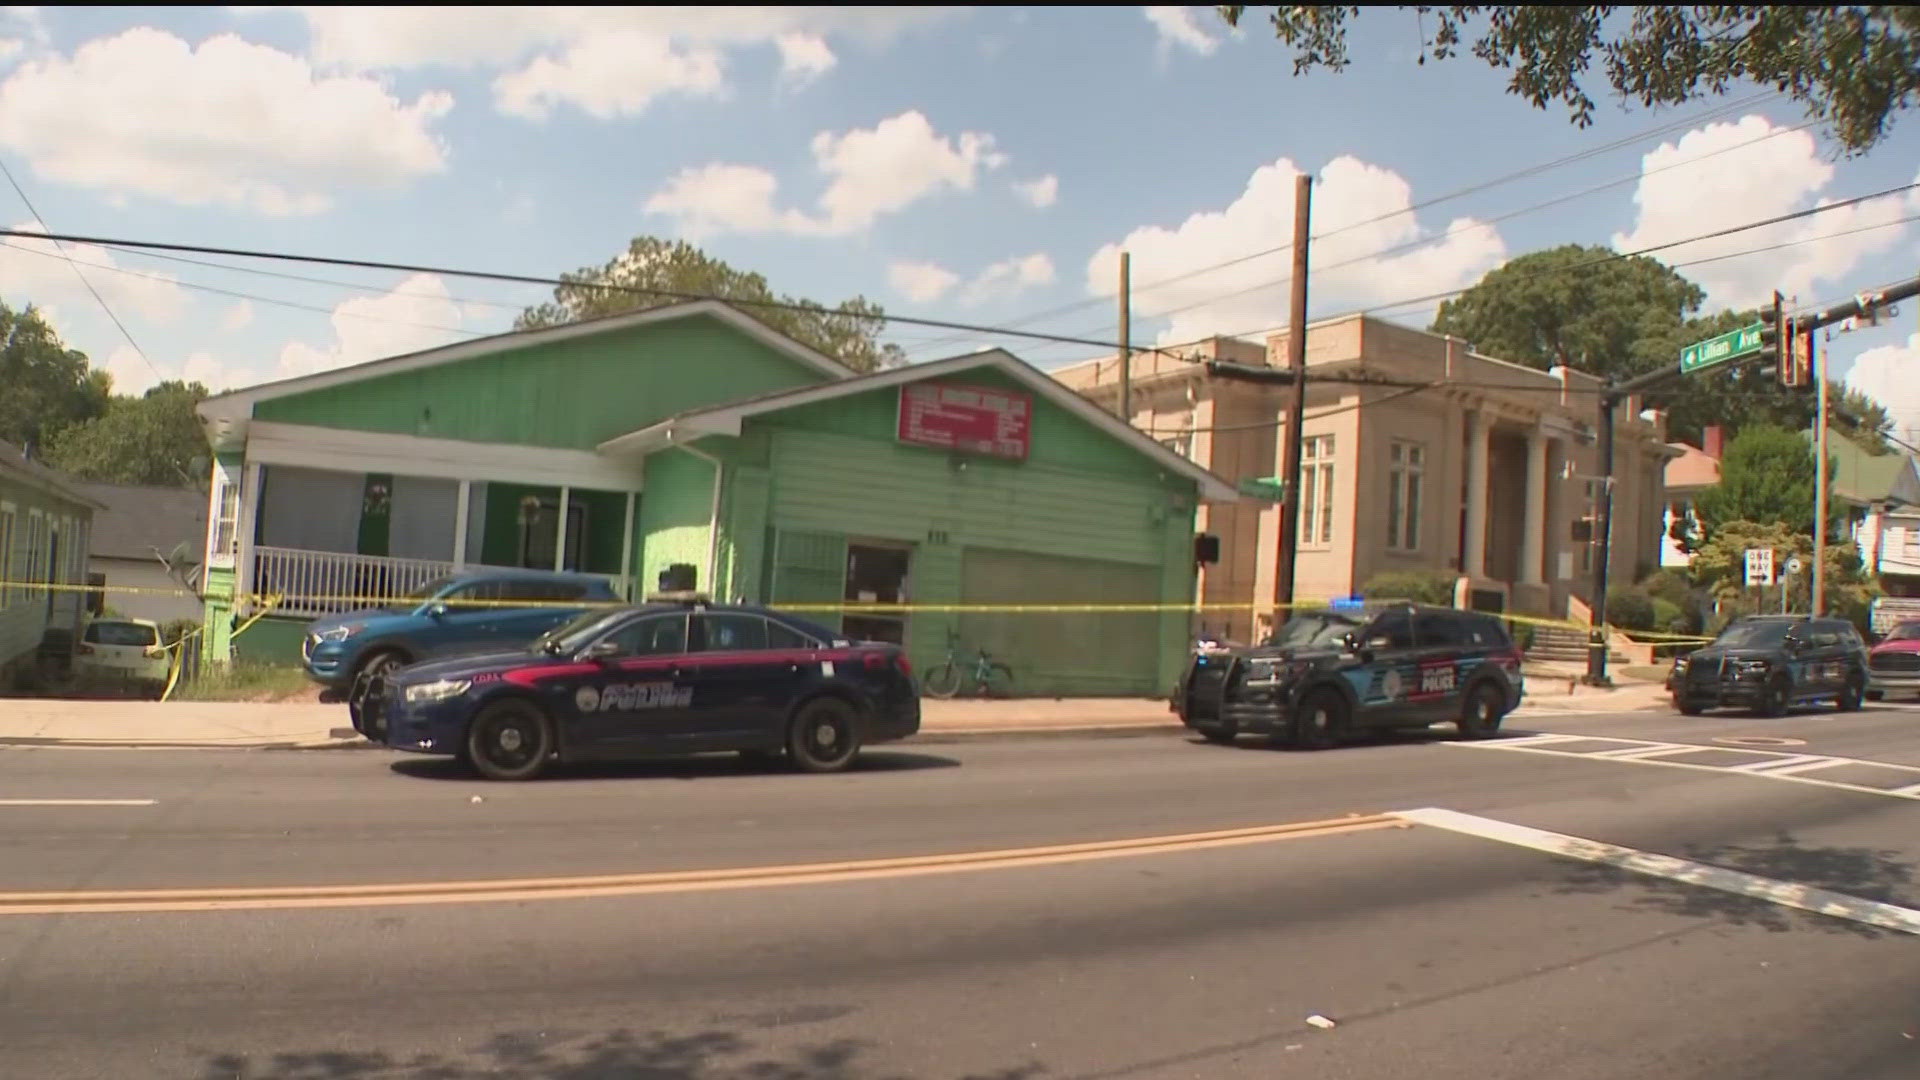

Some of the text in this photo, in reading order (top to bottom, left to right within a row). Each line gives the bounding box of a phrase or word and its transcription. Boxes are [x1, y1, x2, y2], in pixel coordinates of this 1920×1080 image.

[1698, 331, 1761, 362] Lillian Ave
[1749, 551, 1770, 560] ONE
[1749, 562, 1770, 571] WAY
[1422, 674, 1454, 692] POLICE
